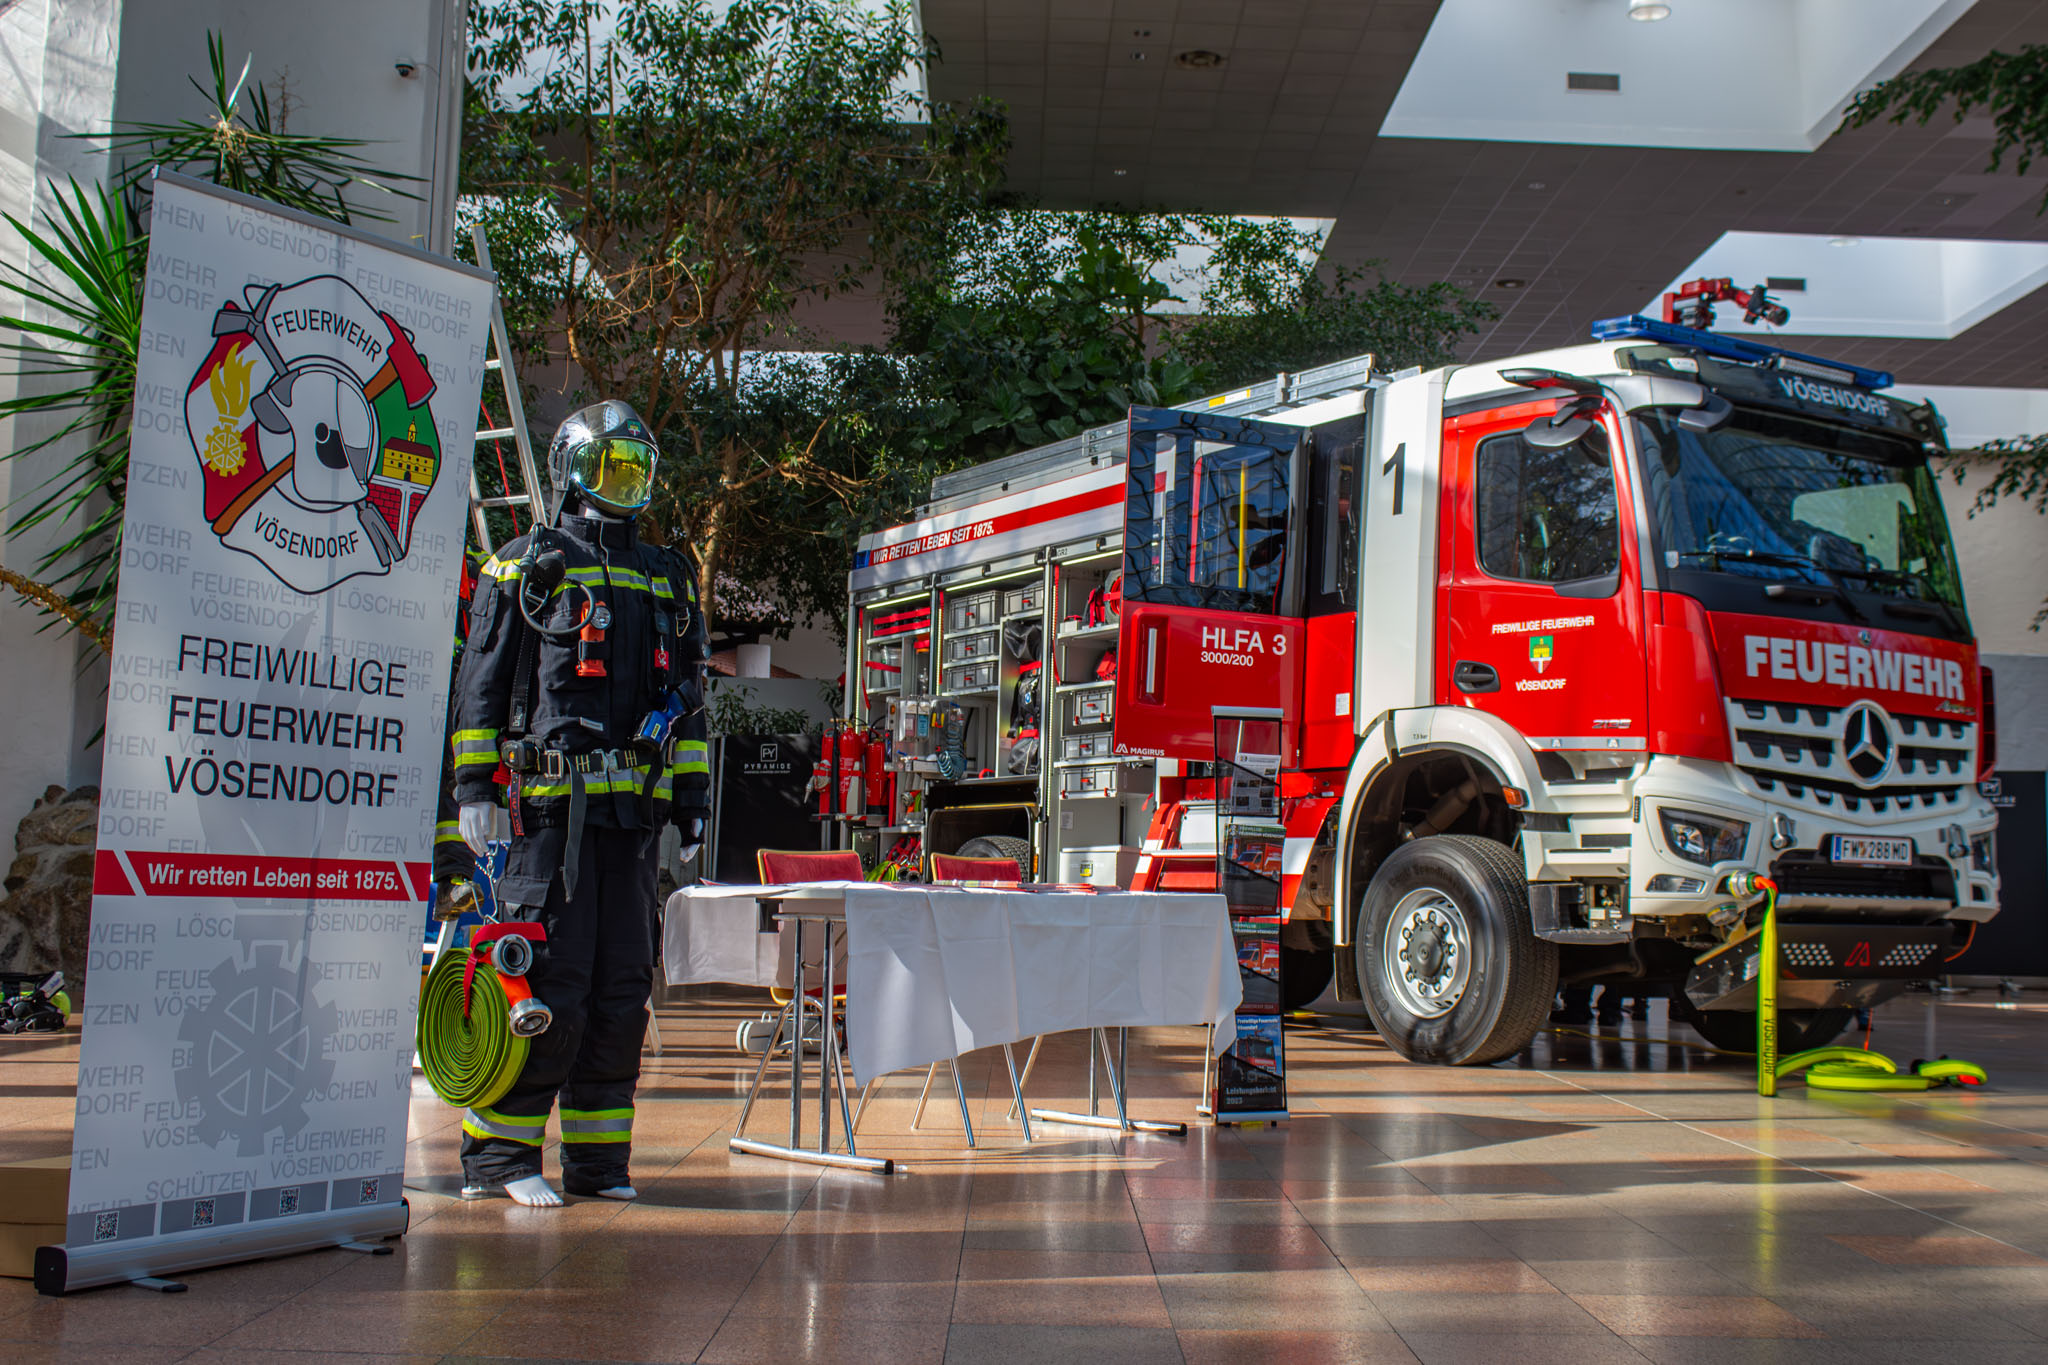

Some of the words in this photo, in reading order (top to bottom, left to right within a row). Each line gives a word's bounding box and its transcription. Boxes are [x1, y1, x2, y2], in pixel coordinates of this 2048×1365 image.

[226, 213, 355, 270] VÖSENDORF
[355, 267, 472, 319] FEUERWEHR
[271, 309, 383, 363] FEUERWEHR
[1778, 376, 1891, 418] VÖSENDORF
[1382, 442, 1406, 516] 1
[255, 511, 360, 560] VÖSENDORF
[873, 548, 889, 564] WIR
[888, 540, 922, 560] RETTEN
[921, 532, 952, 551] LEBEN
[951, 526, 972, 544] SEIT
[972, 521, 995, 538] 1875.
[338, 587, 427, 621] LÖSCHEN
[1202, 626, 1265, 654] HLFA
[1272, 634, 1288, 656] 3
[1491, 620, 1541, 635] FREIWILLIGE
[1541, 615, 1595, 631] FEUERWEHR
[178, 633, 407, 699] FREIWILLIGE
[1200, 651, 1254, 667] 3000/200
[1744, 635, 1966, 702] FEUERWEHR
[1515, 678, 1567, 692] VÖSENDORF
[168, 694, 405, 755] FEUERWEHR
[1130, 747, 1165, 757] MAGIRUS
[164, 747, 398, 809] VÖSENDORF
[100, 788, 169, 812] WEHR
[100, 814, 167, 838] DORF
[148, 863, 184, 886] Wir
[188, 867, 247, 886] retten
[253, 866, 311, 889] Leben
[317, 869, 349, 889] seit
[353, 870, 399, 891] 1875.
[271, 1127, 386, 1155] FEUERWEHR
[270, 1150, 384, 1180] VÖSENDORF
[145, 1170, 258, 1202] SCHÜTZEN
